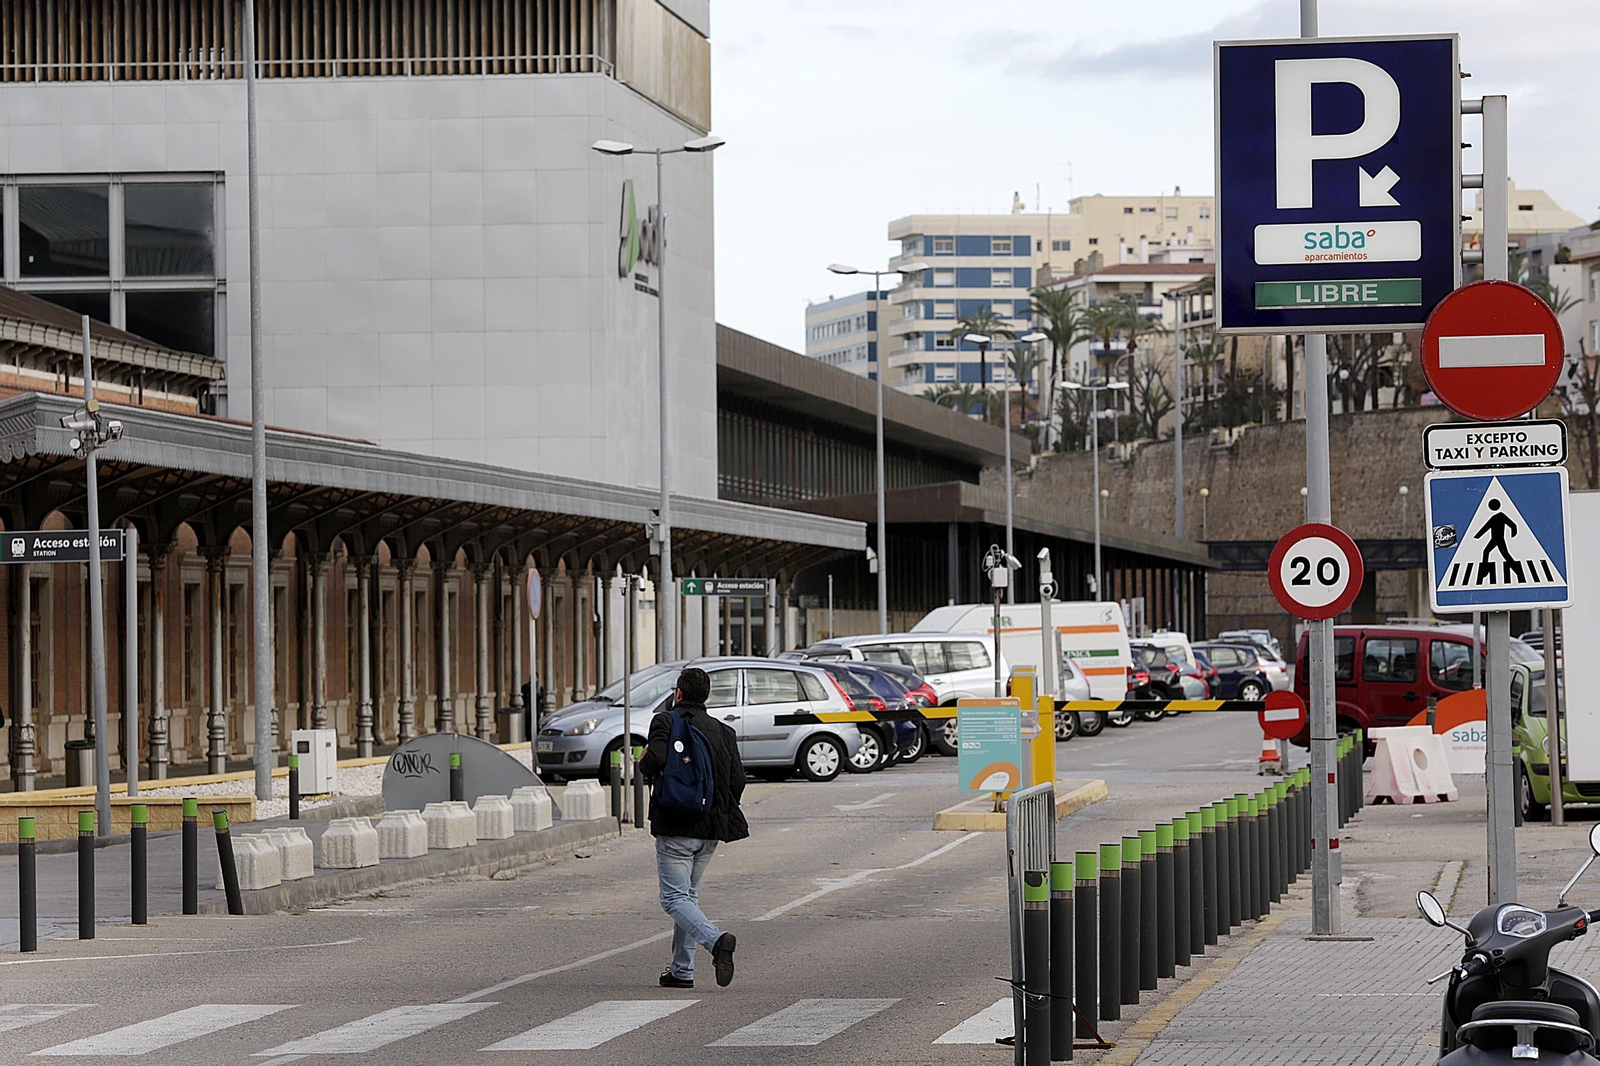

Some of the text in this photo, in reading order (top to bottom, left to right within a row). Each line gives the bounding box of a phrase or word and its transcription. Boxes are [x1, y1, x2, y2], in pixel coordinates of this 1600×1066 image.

[1275, 57, 1401, 209] P
[1304, 225, 1366, 250] saba
[1304, 252, 1368, 263] aparcamientos
[1296, 283, 1379, 303] LIBRE
[1466, 432, 1527, 445] EXCEPTO
[1435, 443, 1559, 460] TAXI Y PARKING
[33, 536, 117, 549] Acceso estión
[1290, 556, 1341, 586] 20
[739, 581, 764, 589] estación
